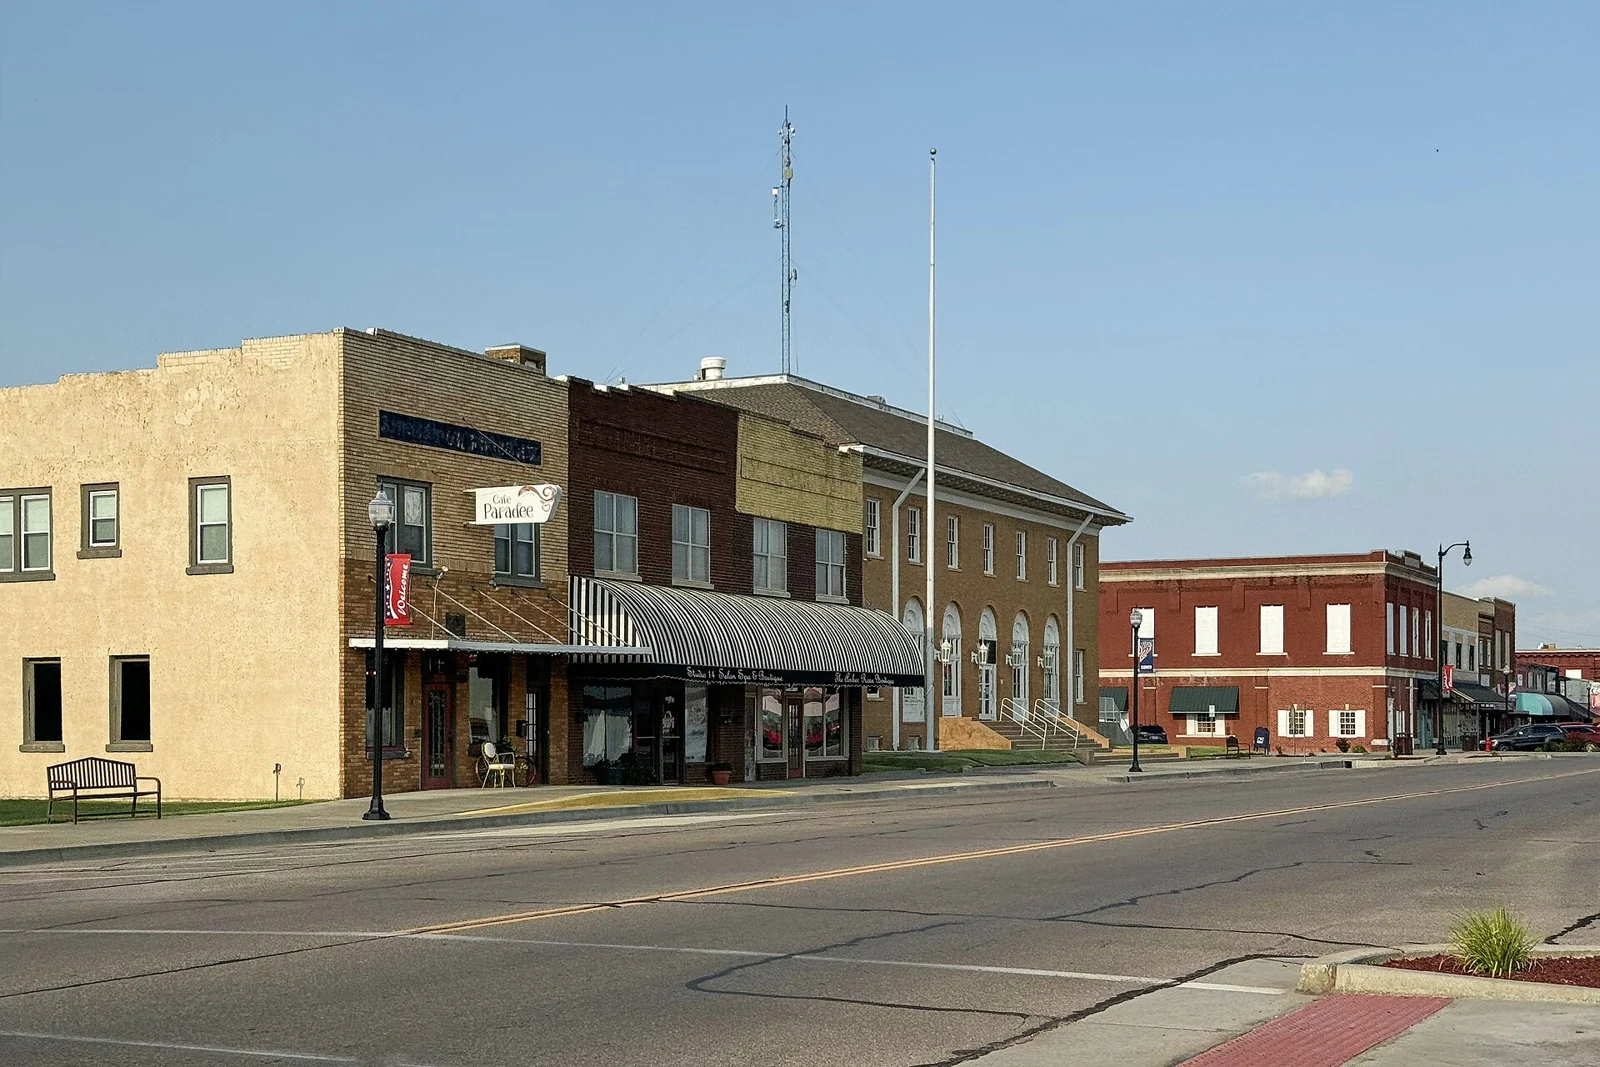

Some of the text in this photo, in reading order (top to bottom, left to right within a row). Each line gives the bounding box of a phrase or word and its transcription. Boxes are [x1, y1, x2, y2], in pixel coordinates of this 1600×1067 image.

[492, 494, 512, 504] Cafe
[484, 502, 534, 519] Paradee
[397, 564, 408, 616] Welcome
[686, 666, 706, 678] Studio
[708, 669, 715, 679] 14
[718, 668, 736, 680] Salon
[737, 669, 751, 683] Spa
[758, 670, 783, 683] Boutique
[834, 672, 844, 683] The
[874, 674, 894, 685] Boutique
